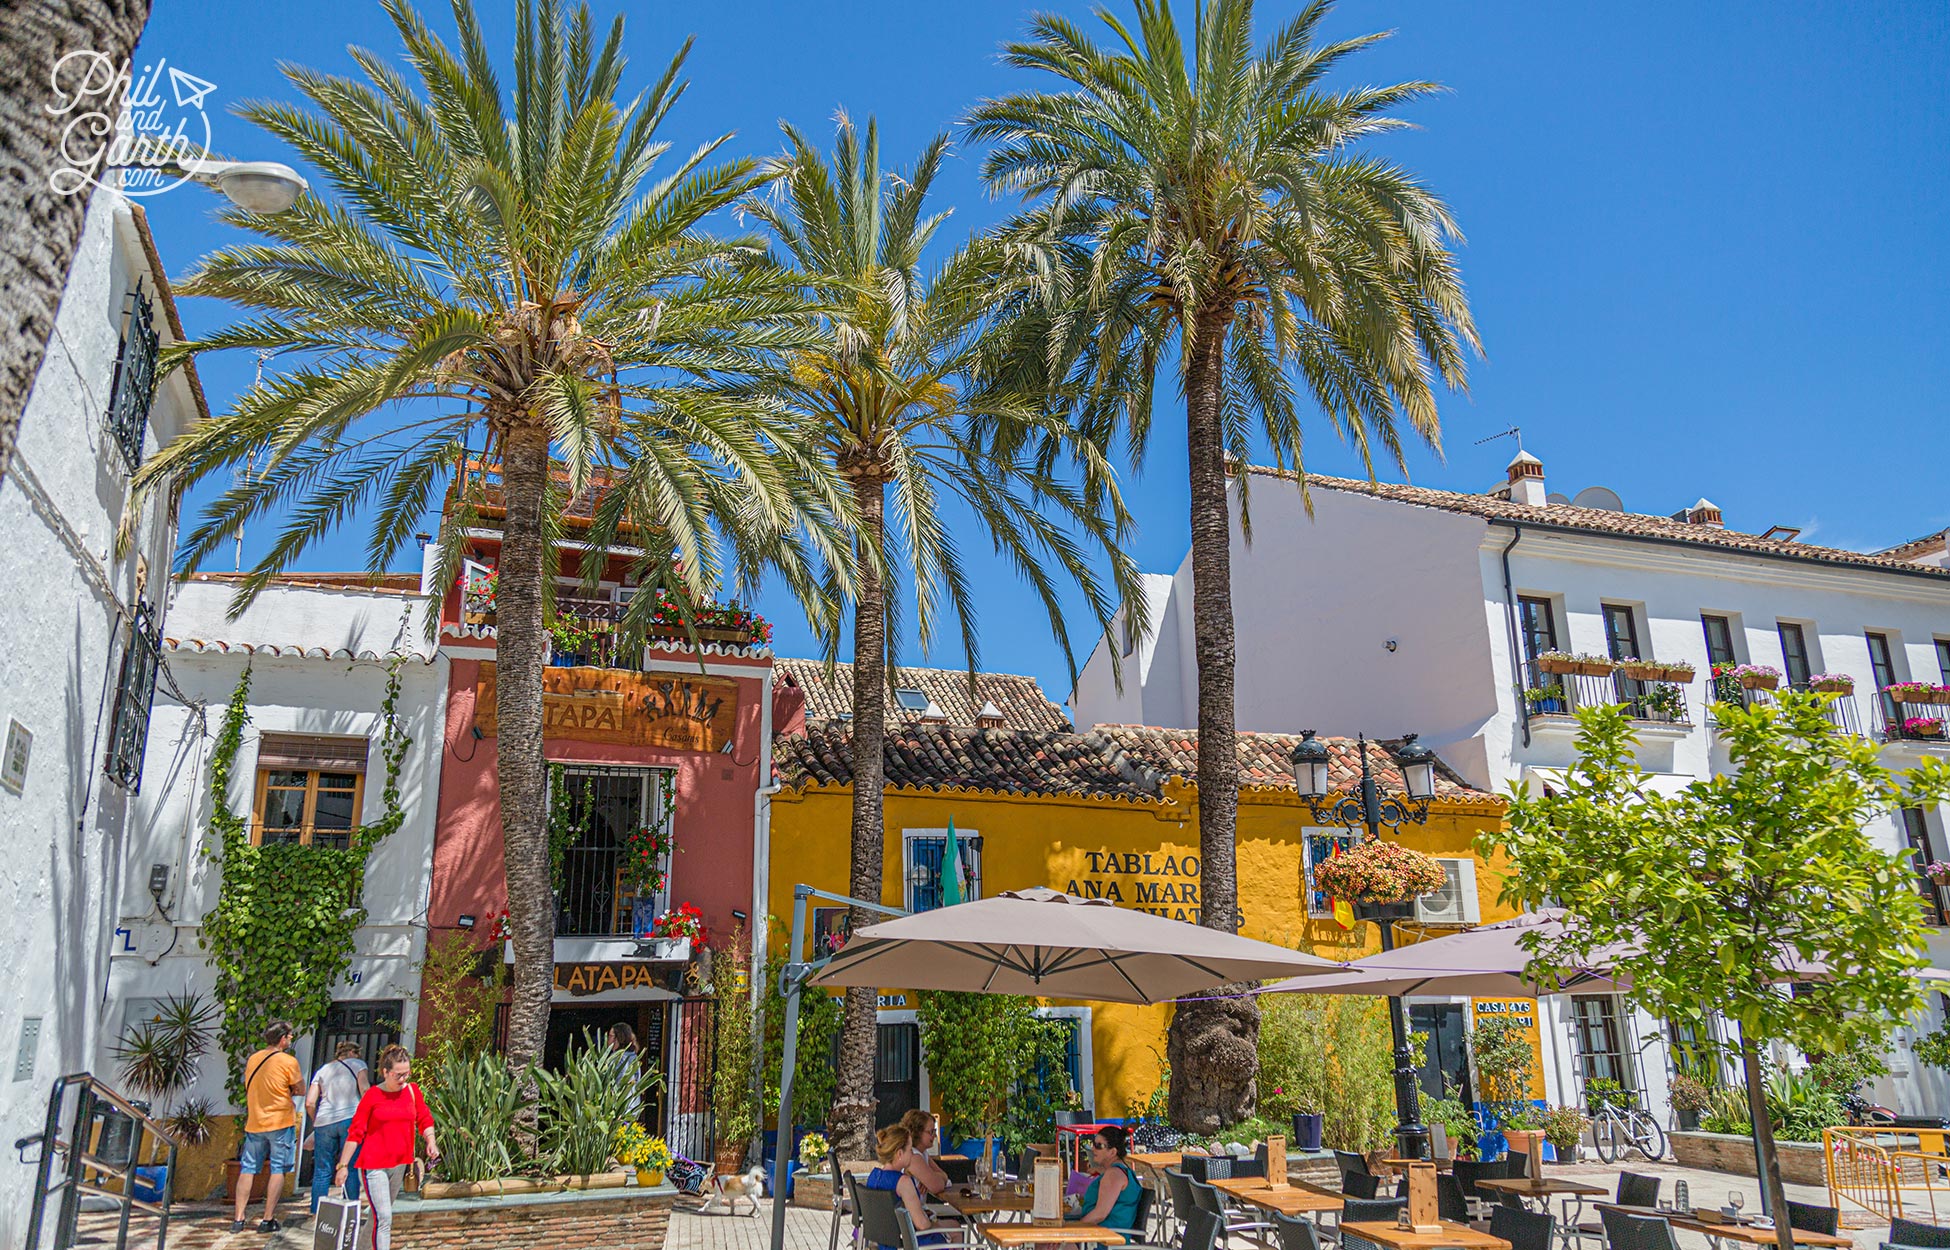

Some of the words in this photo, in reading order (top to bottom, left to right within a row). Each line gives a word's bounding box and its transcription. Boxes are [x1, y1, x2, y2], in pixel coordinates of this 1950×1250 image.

[543, 702, 616, 731] TAPA
[1085, 852, 1201, 877] TABLAO
[1066, 879, 1125, 903] ANA
[1135, 882, 1201, 904] MAR
[1476, 1002, 1507, 1013] CASA
